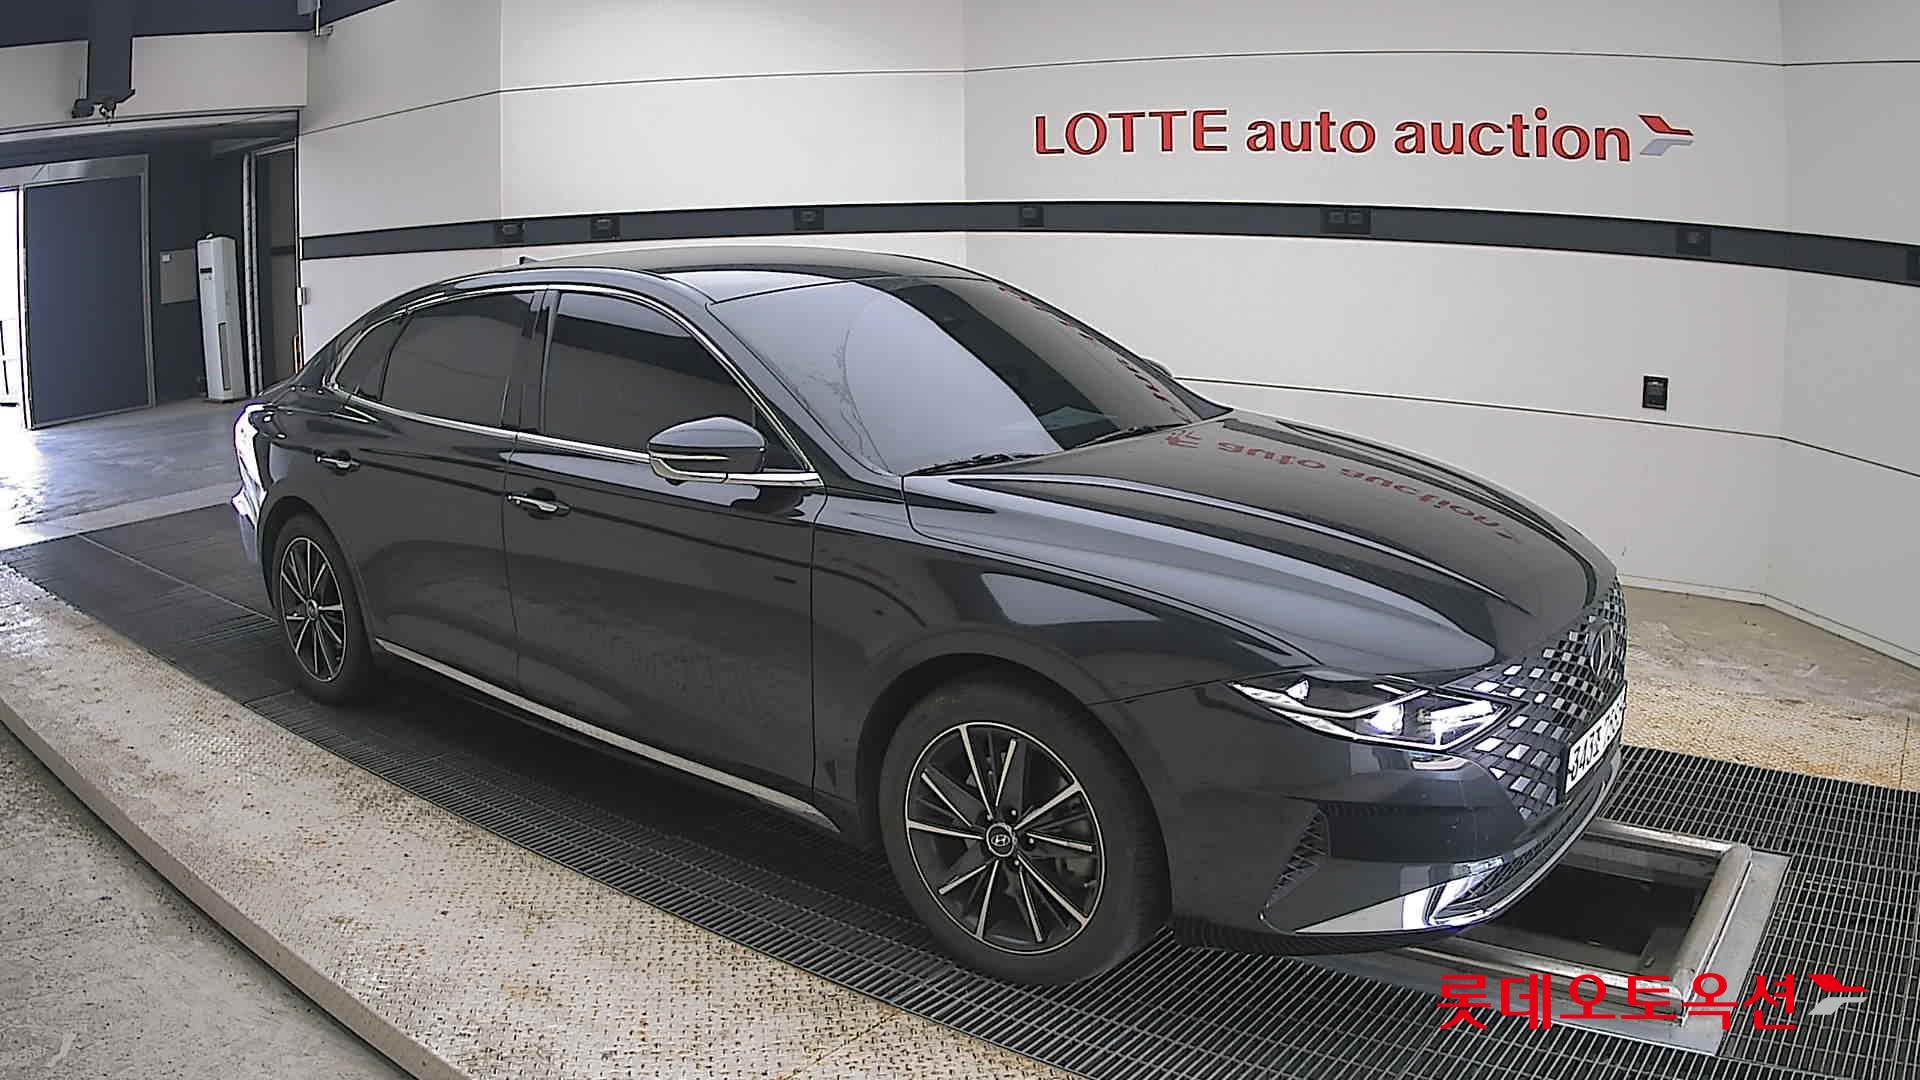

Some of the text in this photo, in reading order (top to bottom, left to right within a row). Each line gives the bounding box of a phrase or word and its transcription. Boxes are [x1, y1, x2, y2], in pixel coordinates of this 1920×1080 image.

[1035, 106, 1632, 162] LOTTE auto auction
